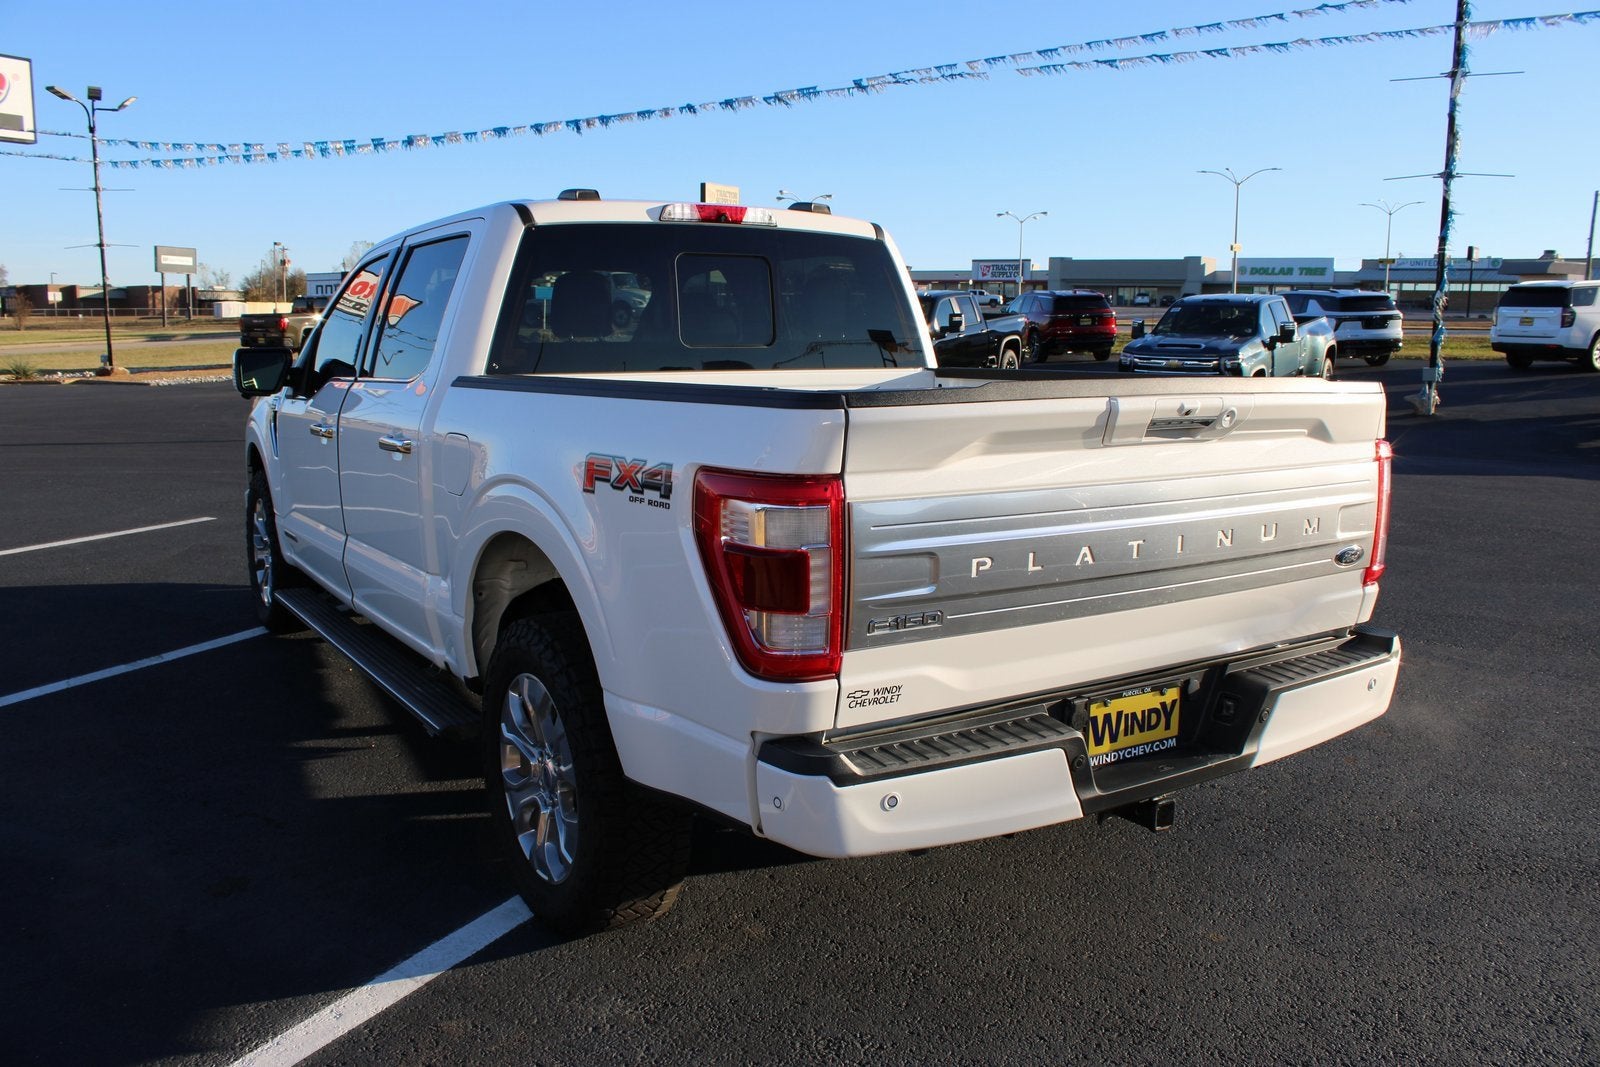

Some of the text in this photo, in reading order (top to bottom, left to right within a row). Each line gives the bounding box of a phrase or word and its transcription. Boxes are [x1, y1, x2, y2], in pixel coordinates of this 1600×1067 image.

[1249, 267, 1327, 276] DOLLAR TREE
[583, 452, 673, 500] FX4
[629, 495, 671, 510] OFF ROAD
[971, 517, 1321, 578] PLATINUM
[873, 684, 903, 696] WINDY
[848, 694, 902, 709] CHEVROLET
[1089, 698, 1178, 747] WINDY
[1089, 738, 1177, 767] WINDYCHEV.COM
